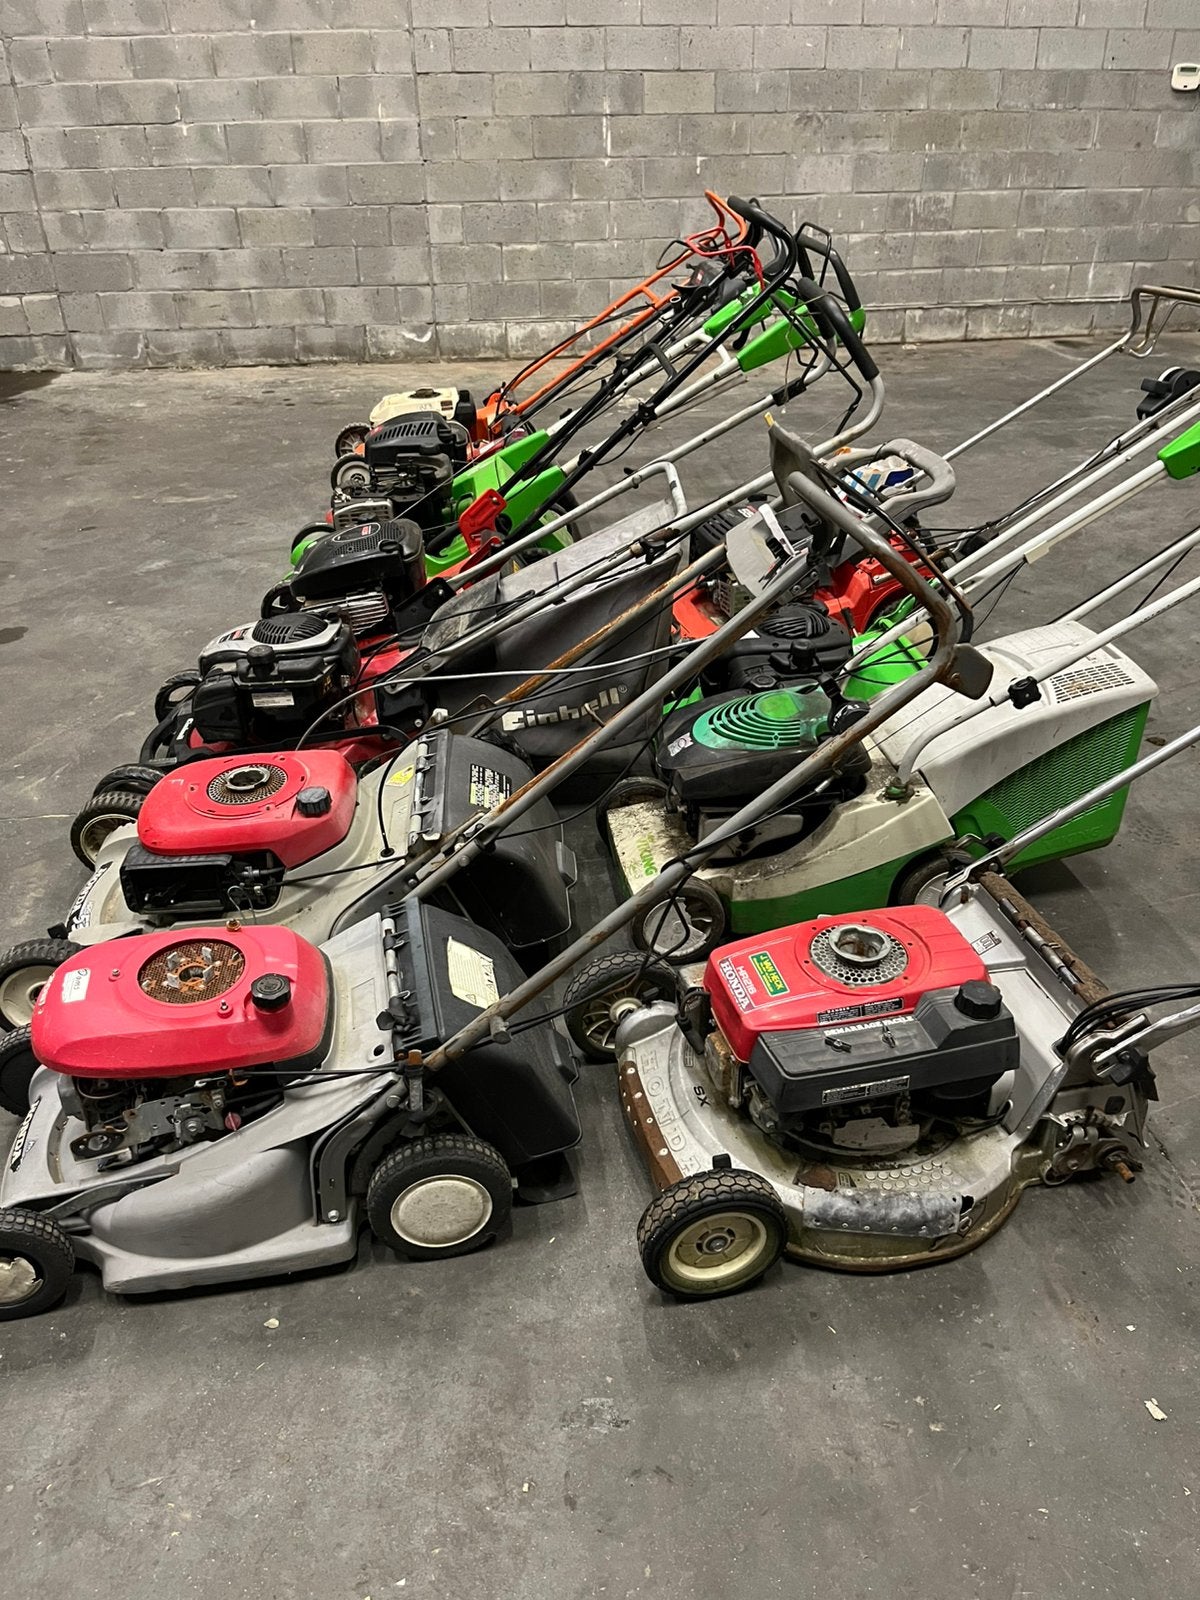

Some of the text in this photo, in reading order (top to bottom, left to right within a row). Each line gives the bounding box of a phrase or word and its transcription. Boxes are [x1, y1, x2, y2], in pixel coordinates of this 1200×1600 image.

[501, 687, 620, 731] Einhell
[720, 961, 750, 1010] HONDA
[768, 971, 784, 990] HECK
[823, 1015, 914, 1036] DEMARRAGE FACILE
[640, 1051, 701, 1175] HONDA
[693, 1085, 712, 1107] SX
[11, 1099, 40, 1165] HONDA
